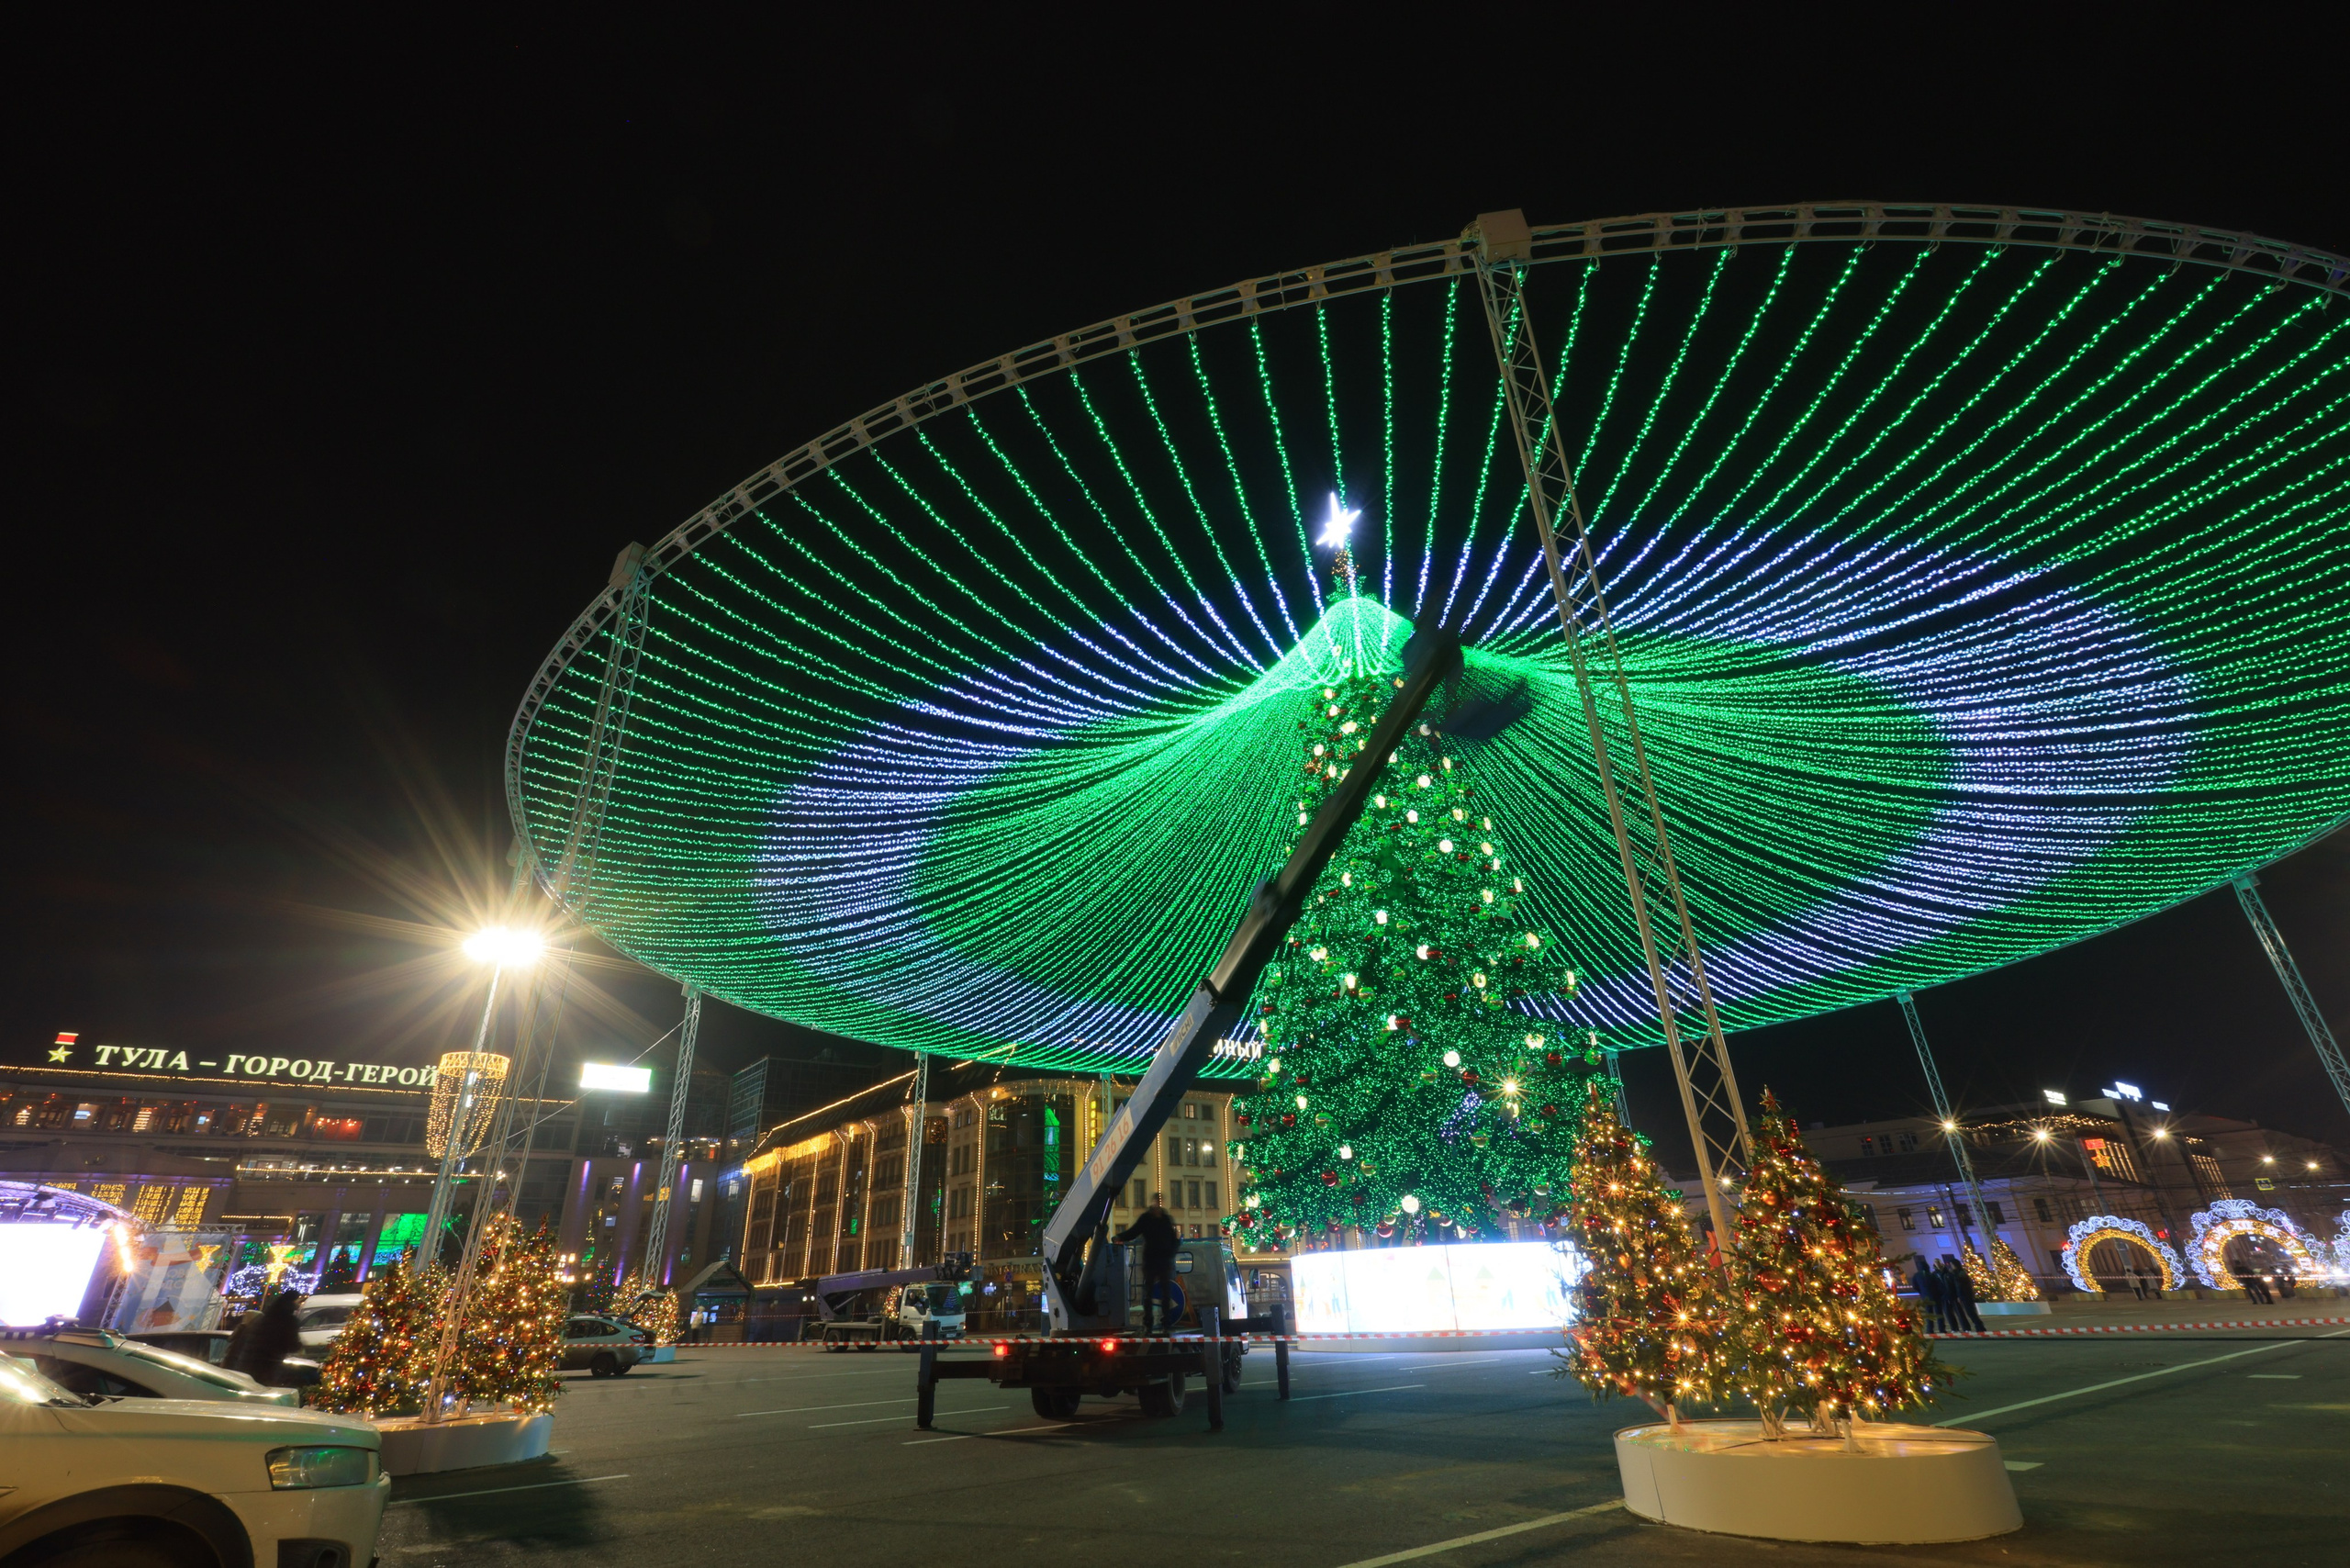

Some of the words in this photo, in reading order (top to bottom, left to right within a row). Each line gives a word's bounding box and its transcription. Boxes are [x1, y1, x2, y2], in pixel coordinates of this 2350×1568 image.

[95, 1045, 189, 1071] ТУЛА
[223, 1054, 438, 1087] ГОРОД-ГЕРОЙ
[1092, 1156, 1105, 1180] 91
[1104, 1137, 1117, 1163] 26
[1117, 1116, 1130, 1141] 16
